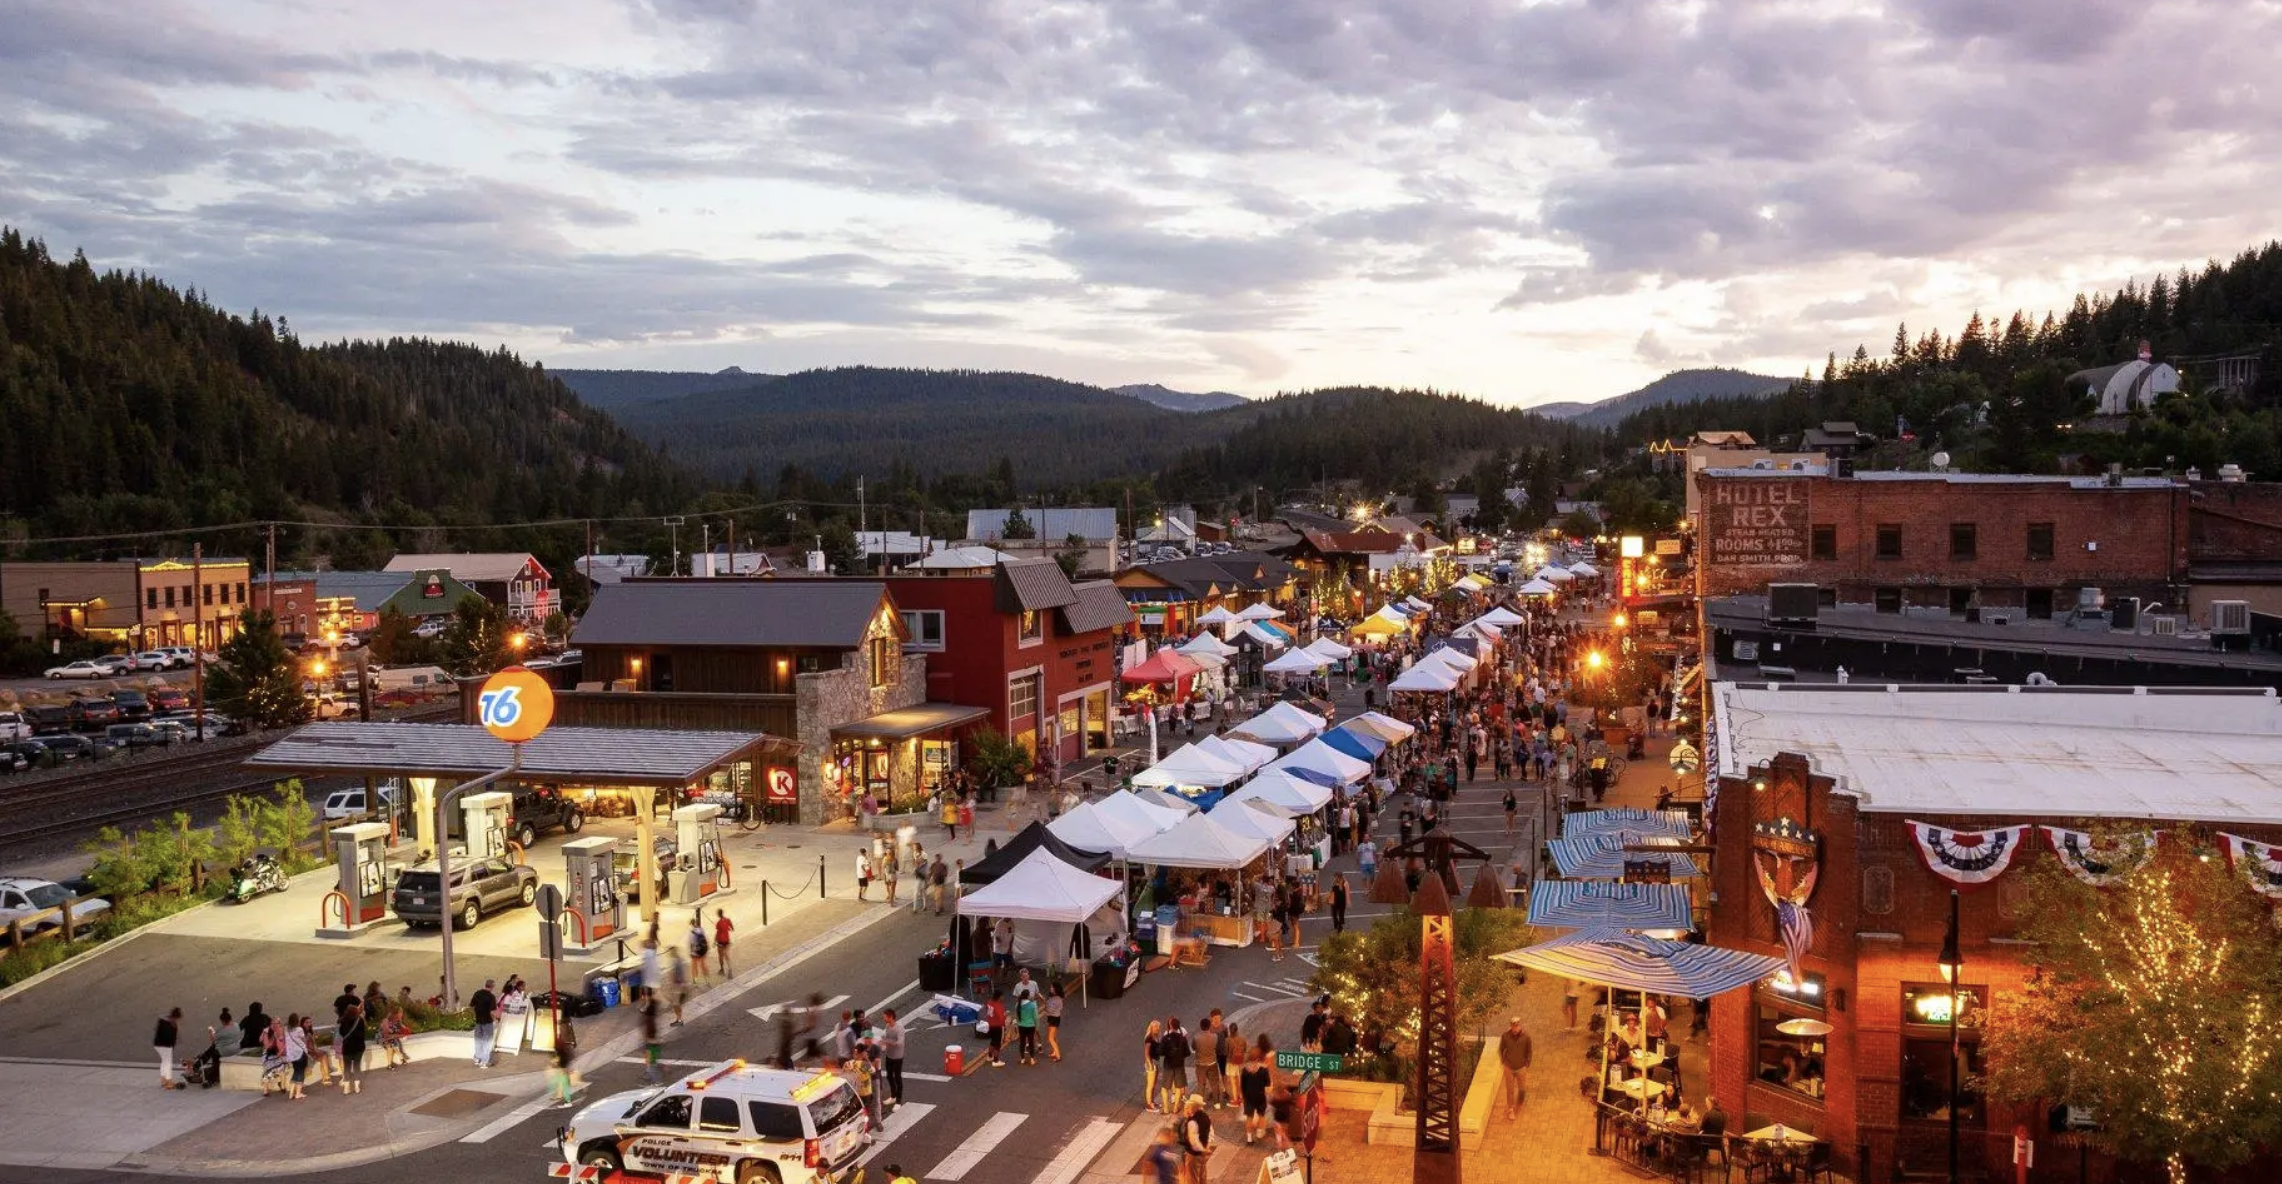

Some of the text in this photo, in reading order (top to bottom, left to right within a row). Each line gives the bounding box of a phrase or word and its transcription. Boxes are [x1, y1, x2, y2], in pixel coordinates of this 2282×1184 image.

[1716, 484, 1800, 505] HOTEL
[1733, 506, 1787, 527] REX
[1725, 528, 1796, 537] STEAM HEATED
[1715, 539, 1763, 552] ROOMS
[1717, 554, 1737, 562] DAN
[479, 688, 521, 726] 76
[1278, 1054, 1340, 1070] BRIDGE ST
[641, 1138, 672, 1146] POLICE
[633, 1146, 731, 1167] VOLUNTEER
[639, 1161, 666, 1169] TOWN
